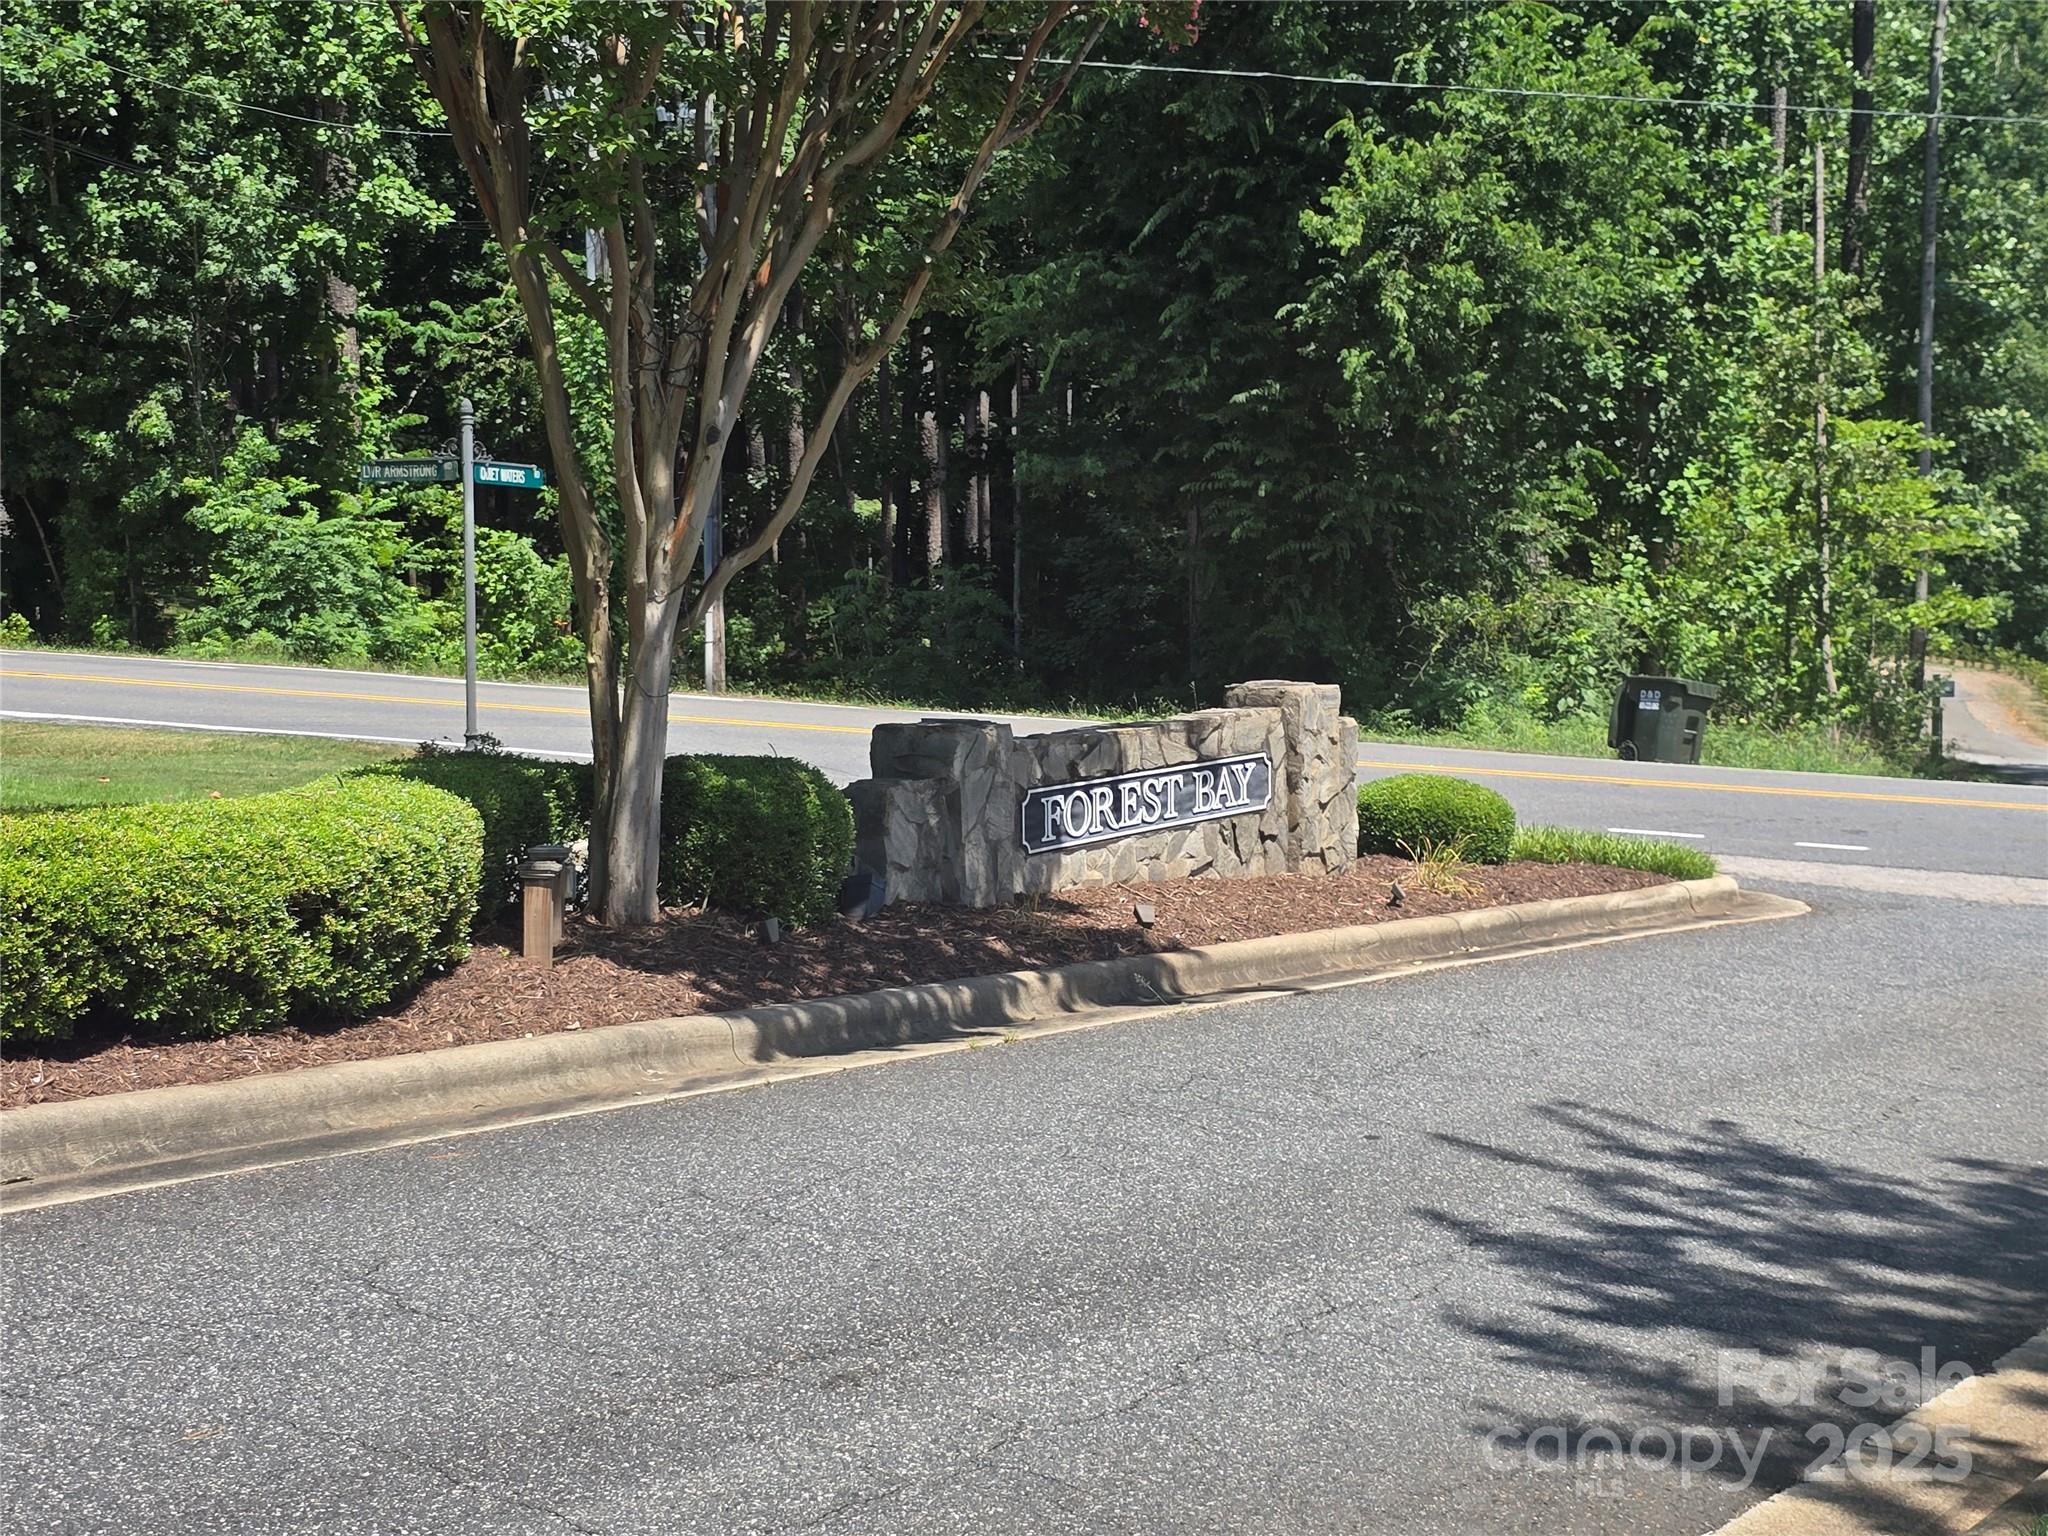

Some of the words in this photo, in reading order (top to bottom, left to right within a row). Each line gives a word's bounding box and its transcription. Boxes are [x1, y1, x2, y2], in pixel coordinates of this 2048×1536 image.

[384, 464, 438, 478] ARMSTRONG
[501, 468, 526, 484] WATERS
[1041, 775, 1184, 842] FOREST
[1193, 762, 1257, 815] BAY
